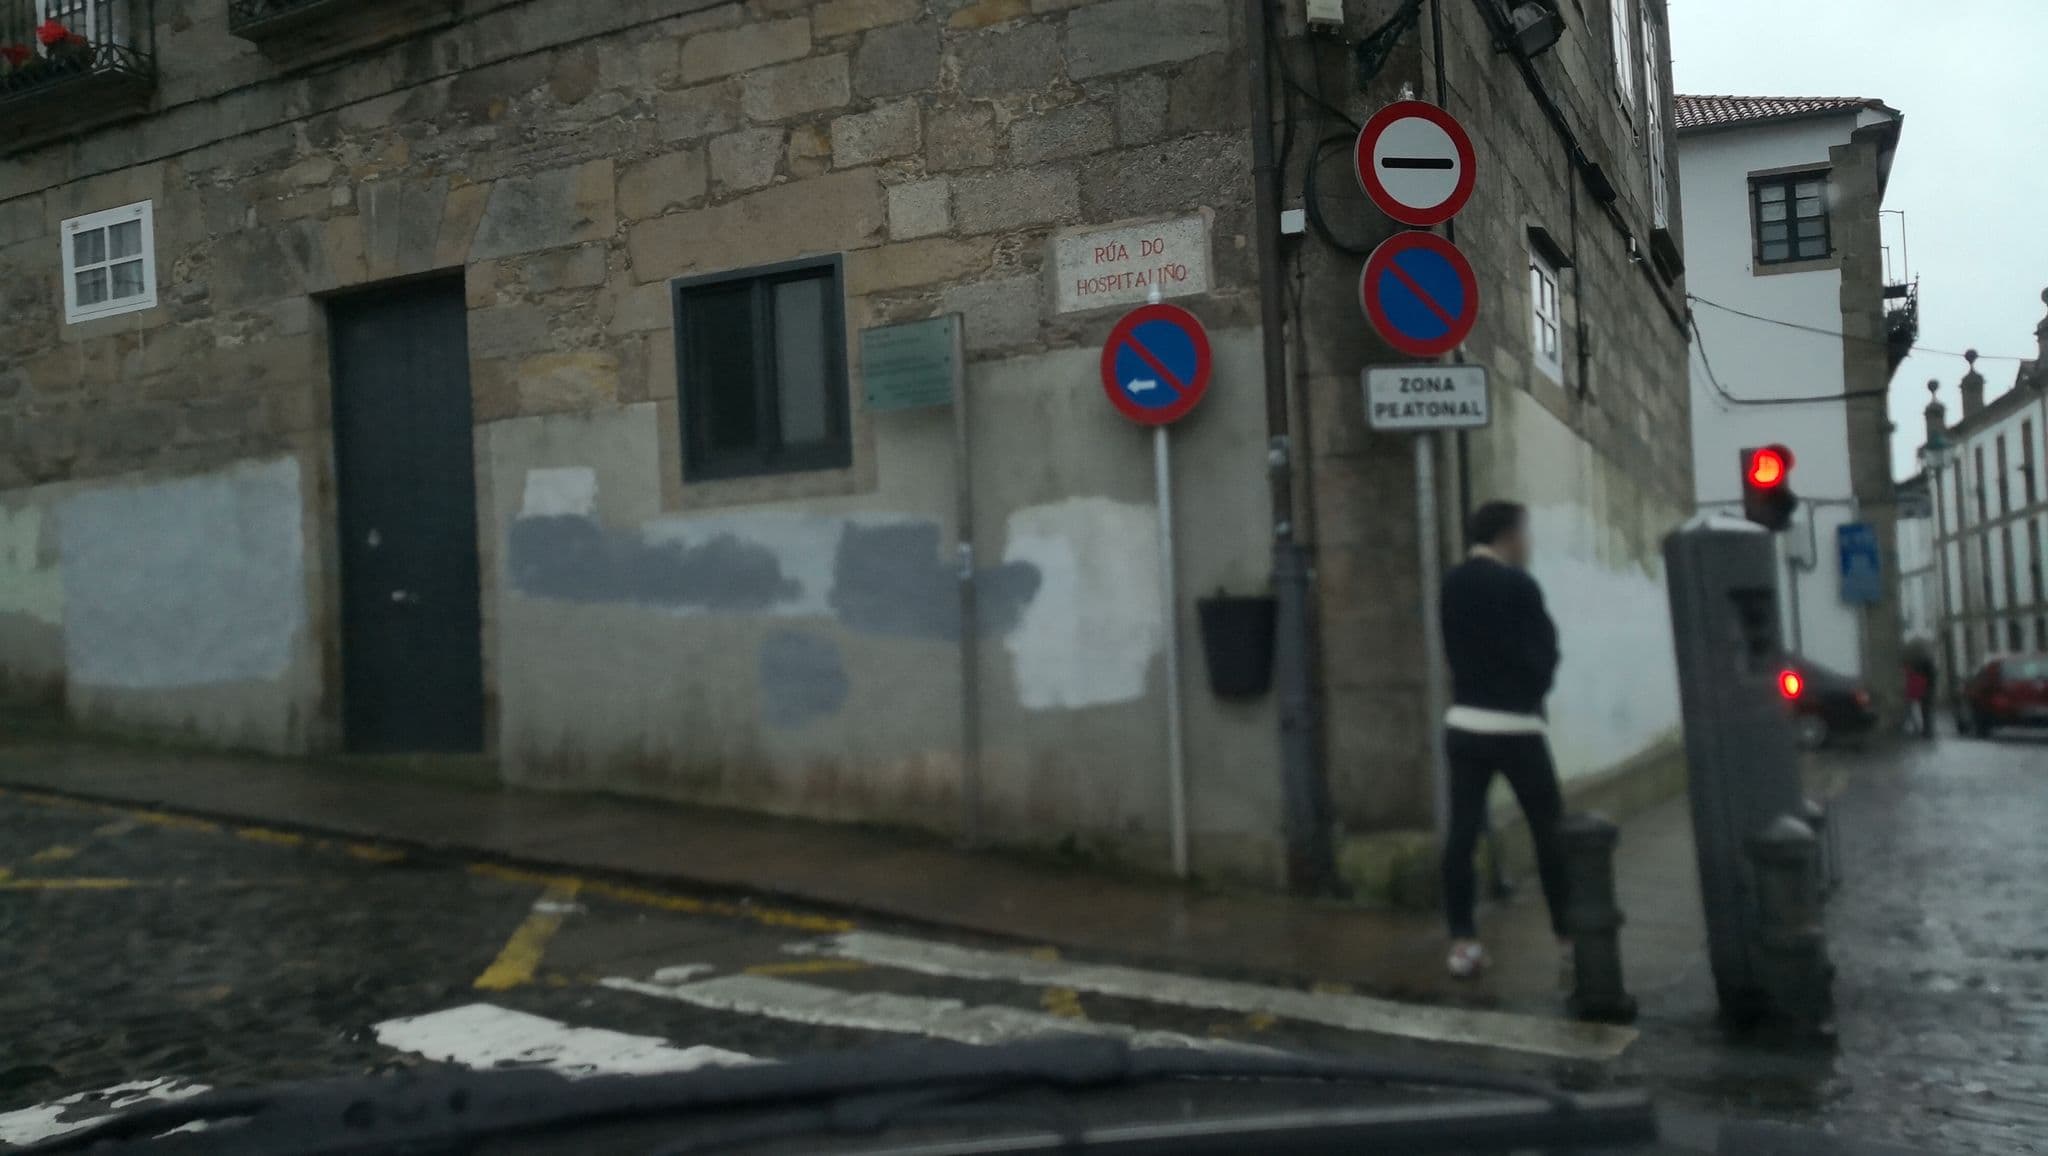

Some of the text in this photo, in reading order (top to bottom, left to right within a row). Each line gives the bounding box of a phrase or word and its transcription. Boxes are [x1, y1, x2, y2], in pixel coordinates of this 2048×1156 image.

[1094, 238, 1164, 264] RÚA DO
[1400, 377, 1455, 393] ZONA
[1375, 401, 1483, 418] PEATONAL
